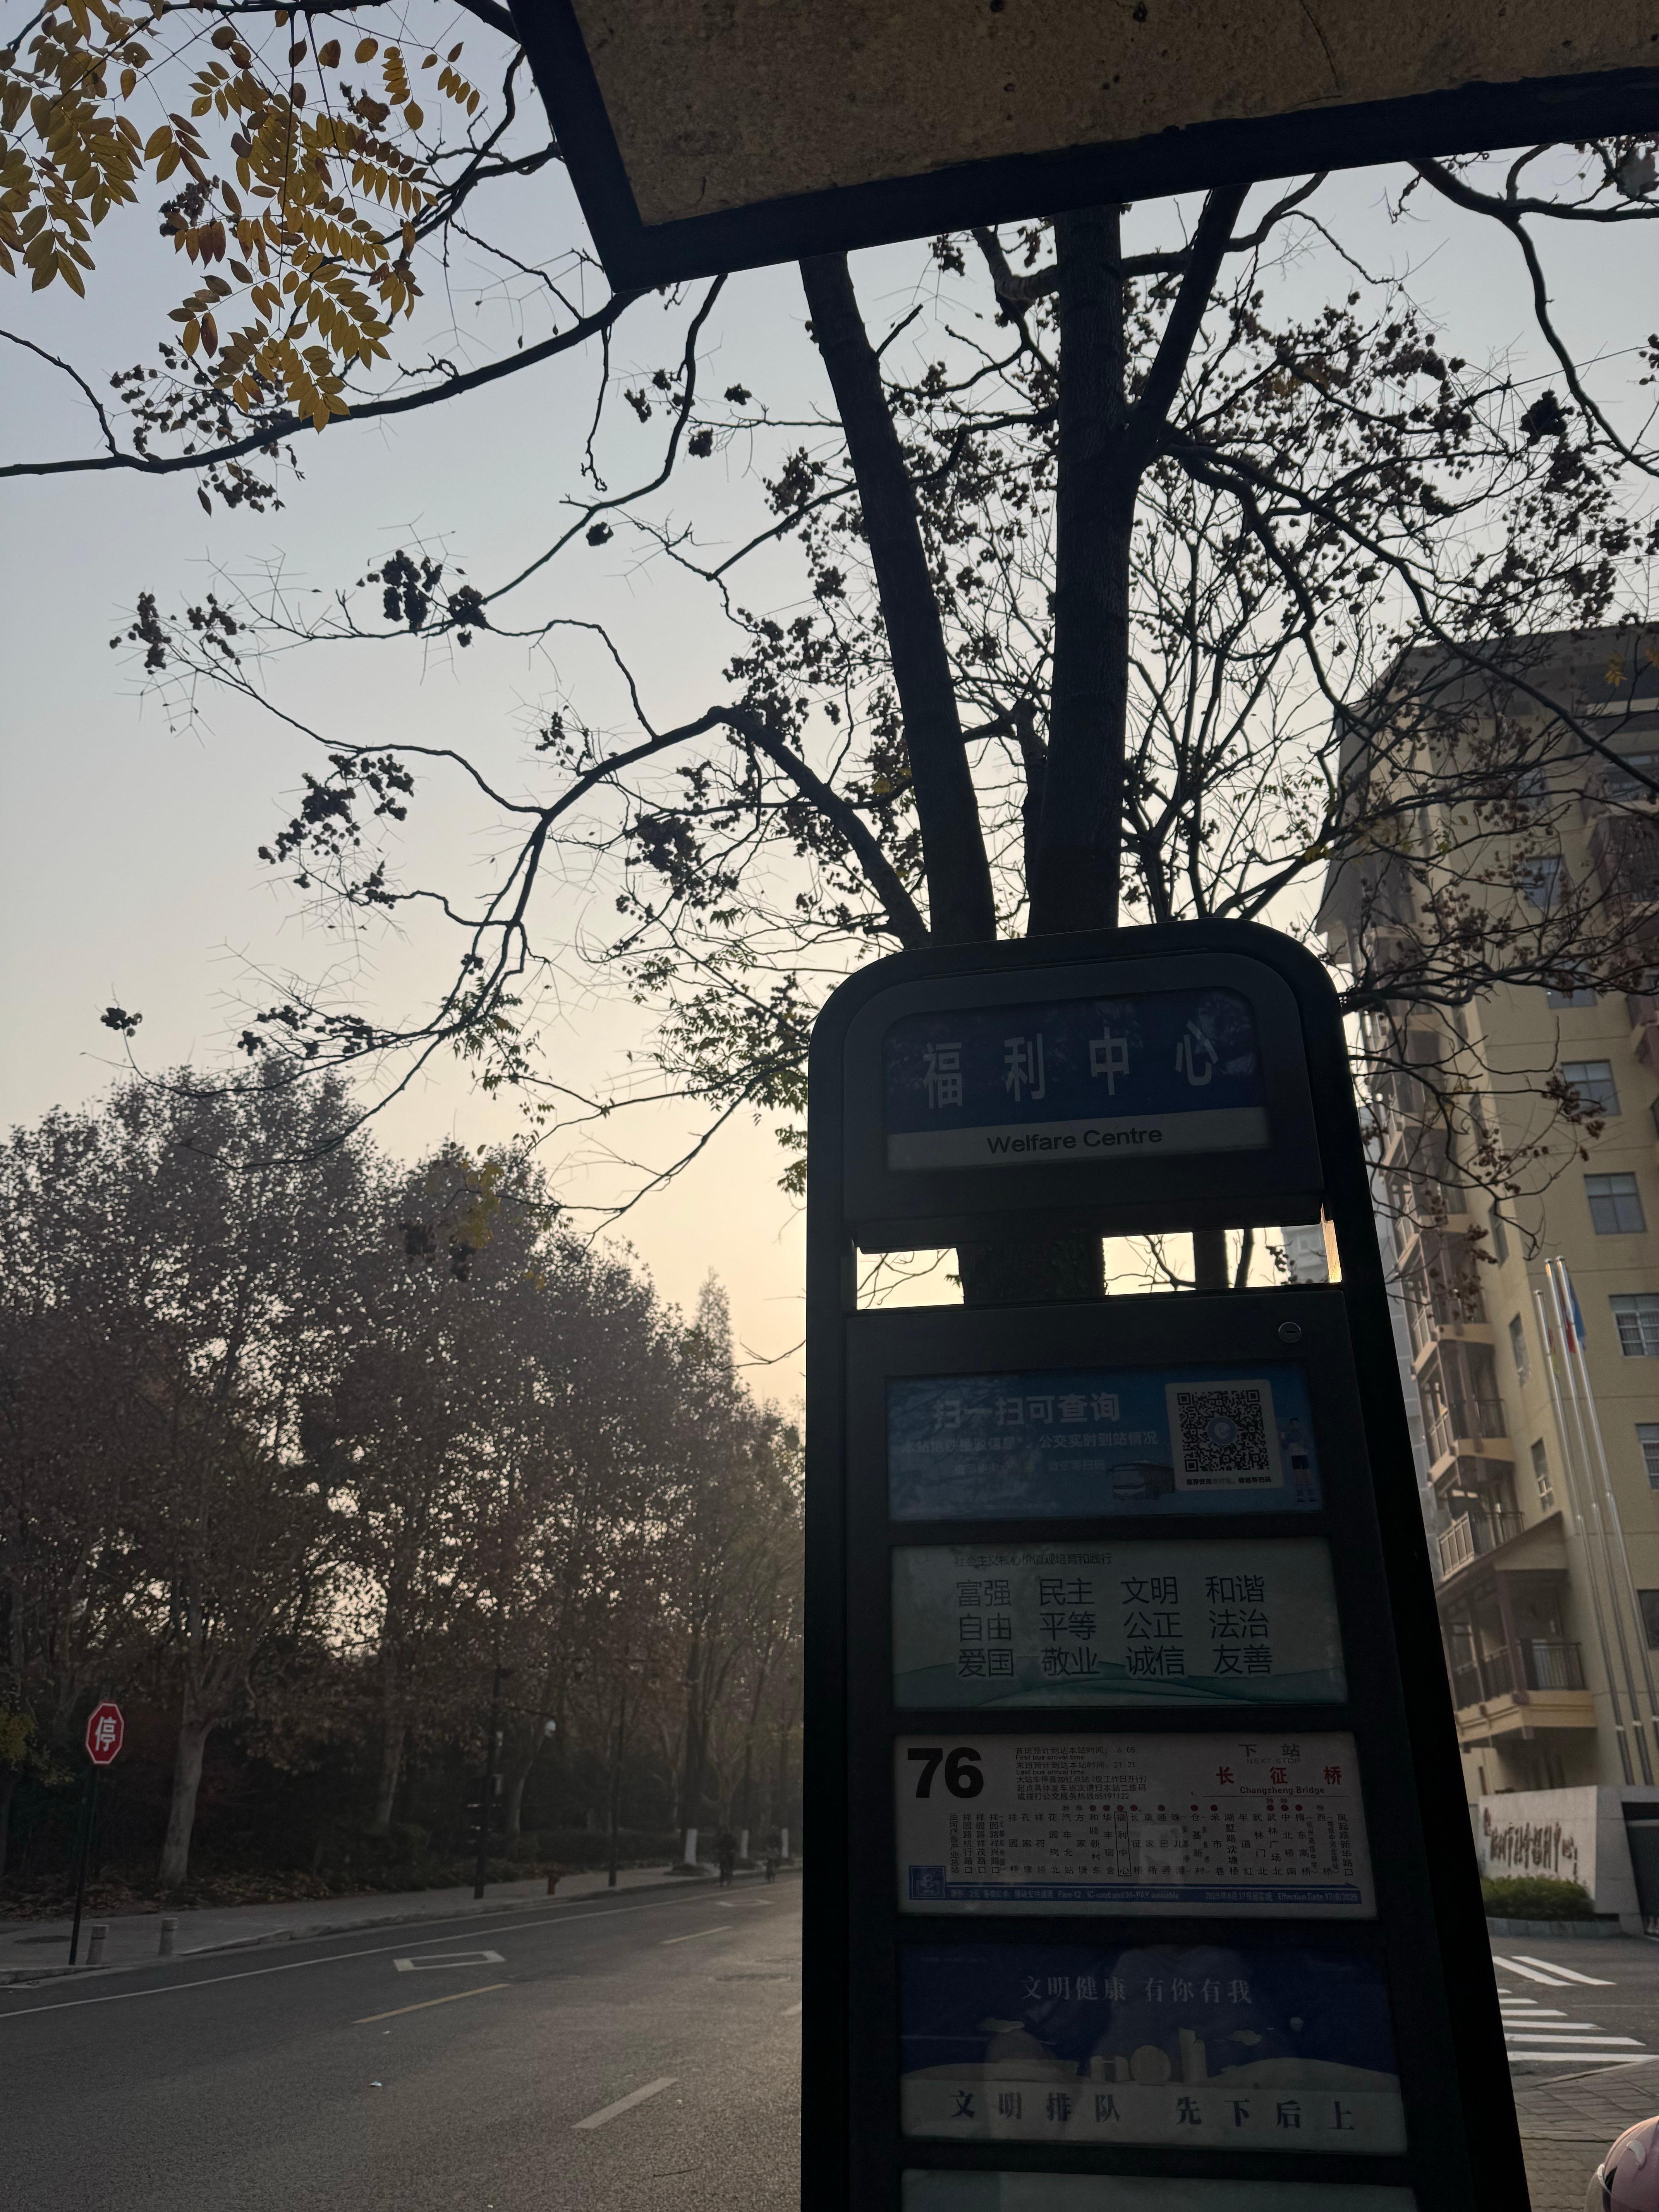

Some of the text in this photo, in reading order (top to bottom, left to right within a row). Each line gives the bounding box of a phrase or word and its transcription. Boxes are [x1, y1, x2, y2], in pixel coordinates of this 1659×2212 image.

[922, 1019, 1218, 1109] 福利中心
[987, 1127, 1162, 1155] Welfare Centre
[932, 1392, 1120, 1429] 扫一扫可查询
[955, 1553, 1112, 1566] 社会主义核心价值观培育和践行
[957, 1574, 1265, 1607] 富强 民主 文明 和谐
[958, 1609, 1269, 1642] 自由 平等 公正 法治
[958, 1645, 1273, 1678] 爱国 敬业 诚信 友善
[95, 1716, 117, 1752] 停
[907, 1747, 984, 1798] 76
[1216, 1766, 1341, 1785] 长征桥
[1240, 1786, 1325, 1795] Changzheng Bridge
[949, 1814, 959, 1873] 运河广告产业总站
[963, 1813, 972, 1874] 祥园路杭行路口
[976, 1813, 986, 1874] 祥园路祥茂路口
[989, 1813, 1000, 1874] 祥园路祥兴路口
[1008, 1814, 1018, 1872] 祥园桥
[1035, 1813, 1046, 1874] 祥符桥
[1048, 1814, 1060, 1873] 花园岗北
[1062, 1814, 1073, 1874] 汽车北站
[1075, 1814, 1087, 1874] 方家塘
[1089, 1814, 1100, 1874] 和睦新村东
[1102, 1814, 1115, 1874] 华丰宿舍
[1116, 1814, 1129, 1874] 福利中心
[1131, 1814, 1141, 1874] 长征桥
[1191, 1814, 1204, 1875] 仓基新村
[1210, 1814, 1224, 1875] 米市巷
[1224, 1814, 1239, 1875] 湖墅路沈塘桥
[1238, 1814, 1253, 1875] 半道红
[1253, 1814, 1268, 1875] 武林门北
[1267, 1814, 1283, 1875] 武林广场北
[1281, 1814, 1296, 1875] 中北桥南
[1296, 1813, 1311, 1876] 梅东高桥
[1316, 1813, 1332, 1875] 西桥
[1338, 1814, 1353, 1876] 凤起路新华路口
[1019, 1974, 1252, 2005] 文明健康 有你有我
[950, 2090, 1355, 2131] 文明排队 先下后上
